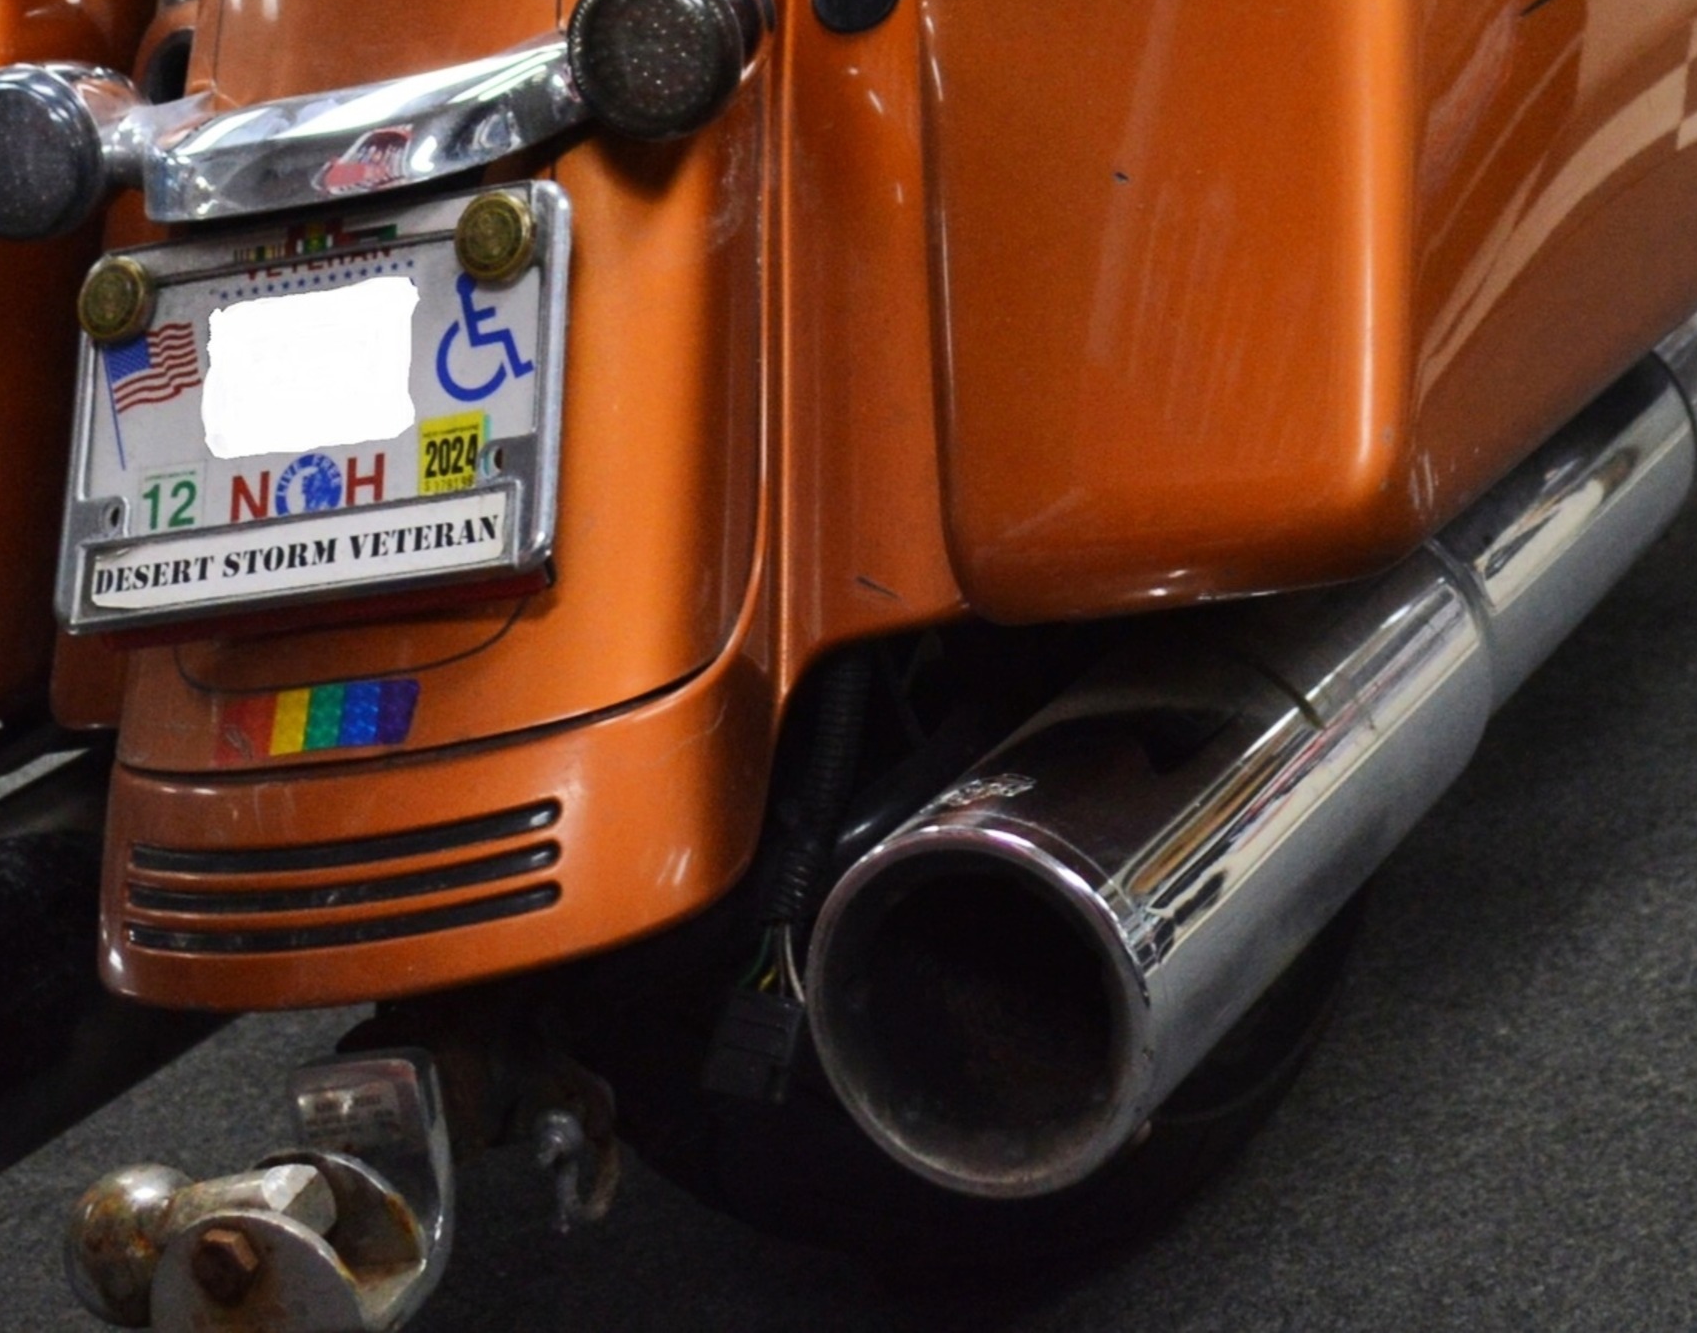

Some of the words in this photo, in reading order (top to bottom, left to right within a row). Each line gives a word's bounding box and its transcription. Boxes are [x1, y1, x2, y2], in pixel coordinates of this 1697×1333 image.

[424, 433, 479, 479] 2024
[142, 480, 198, 530] 12
[94, 555, 215, 596] DESERT
[221, 538, 338, 578] STORM
[349, 514, 499, 561] VETERAN
